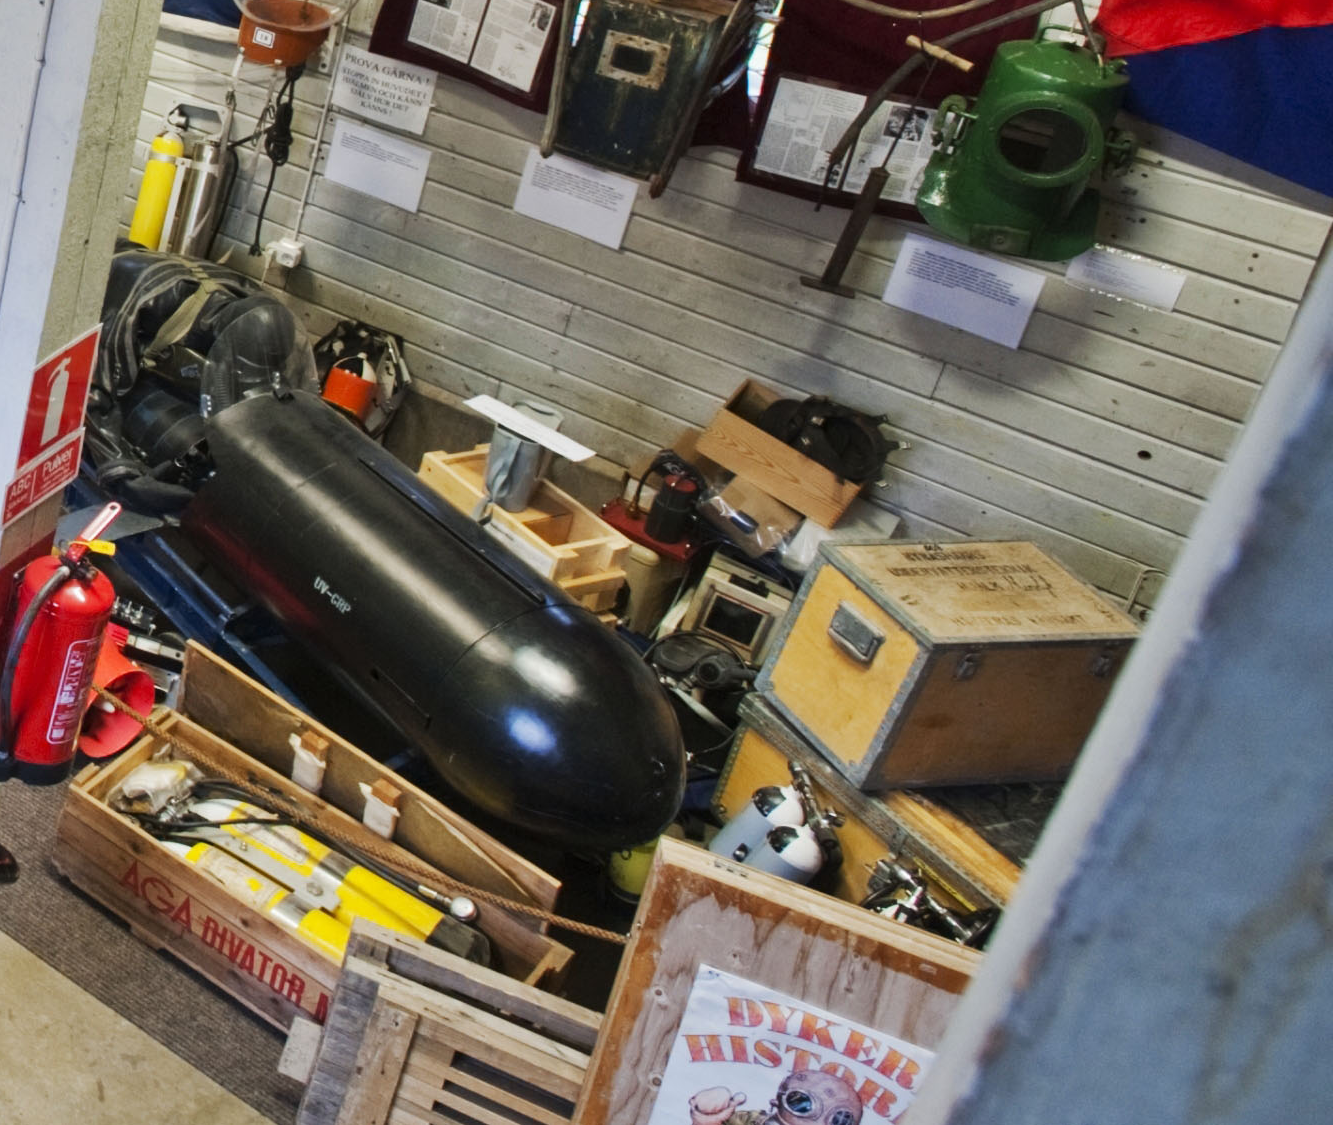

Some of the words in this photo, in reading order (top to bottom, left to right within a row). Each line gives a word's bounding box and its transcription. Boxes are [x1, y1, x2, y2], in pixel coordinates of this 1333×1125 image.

[345, 53, 379, 72] PROVA
[382, 66, 422, 84] GÄRNA
[9, 474, 31, 500] ABC
[42, 447, 73, 478] Pulver
[122, 859, 192, 934] AGA
[201, 915, 306, 1008] DIVATOR
